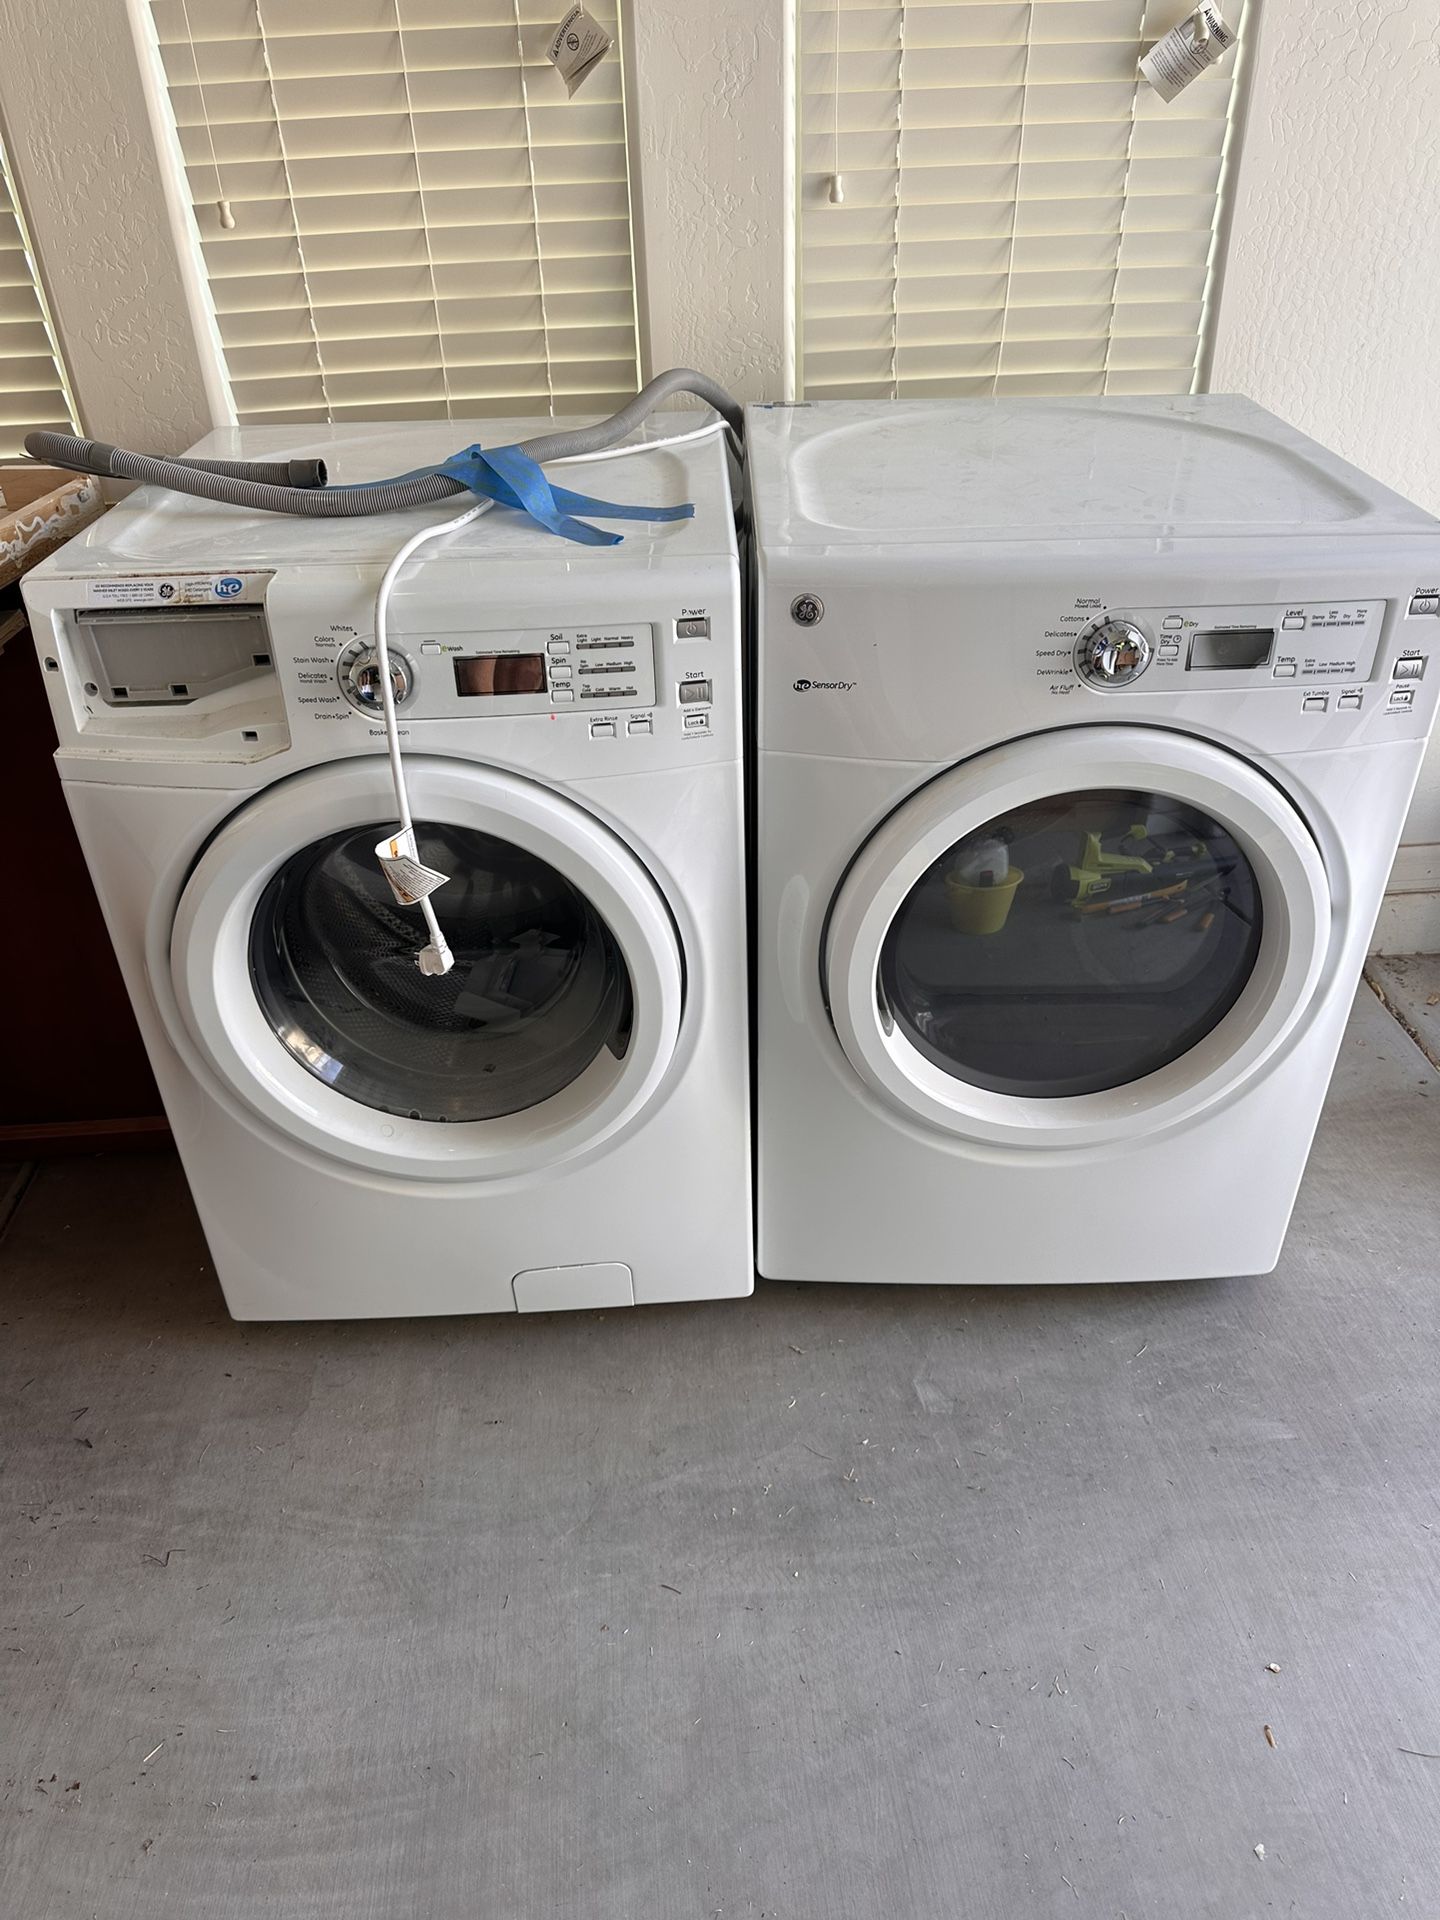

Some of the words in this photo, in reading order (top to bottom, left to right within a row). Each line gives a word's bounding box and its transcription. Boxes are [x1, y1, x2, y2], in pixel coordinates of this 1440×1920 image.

[1206, 14, 1229, 43] WARNING
[1056, 650, 1067, 658] Dry
[293, 656, 310, 664] Stain
[685, 671, 704, 679] Start
